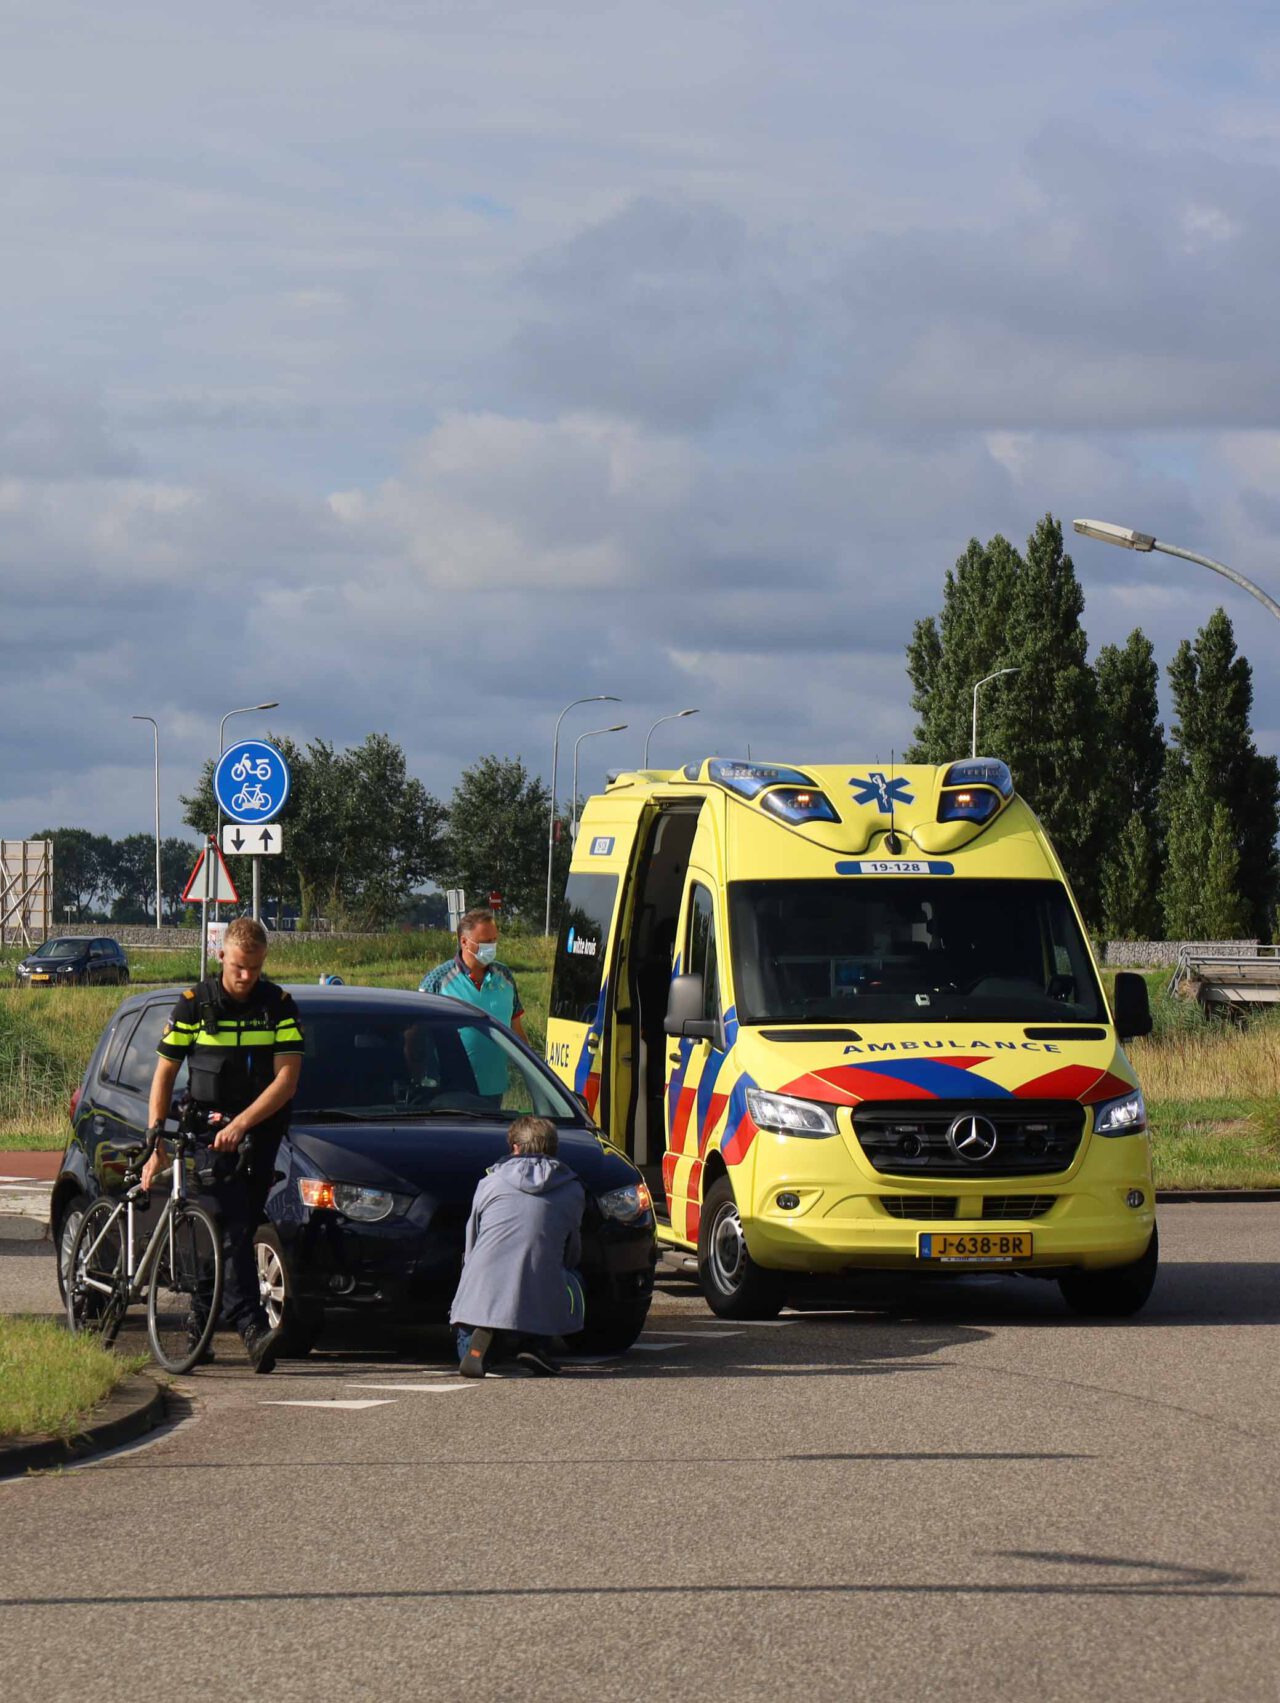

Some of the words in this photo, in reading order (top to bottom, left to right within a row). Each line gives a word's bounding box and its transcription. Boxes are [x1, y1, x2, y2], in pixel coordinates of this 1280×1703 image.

[871, 863, 921, 872] 19-128
[572, 935, 585, 954] witte
[584, 937, 597, 956] kruis
[842, 1040, 1062, 1055] AMBULANCE
[938, 1237, 1023, 1254] J-638-BR
